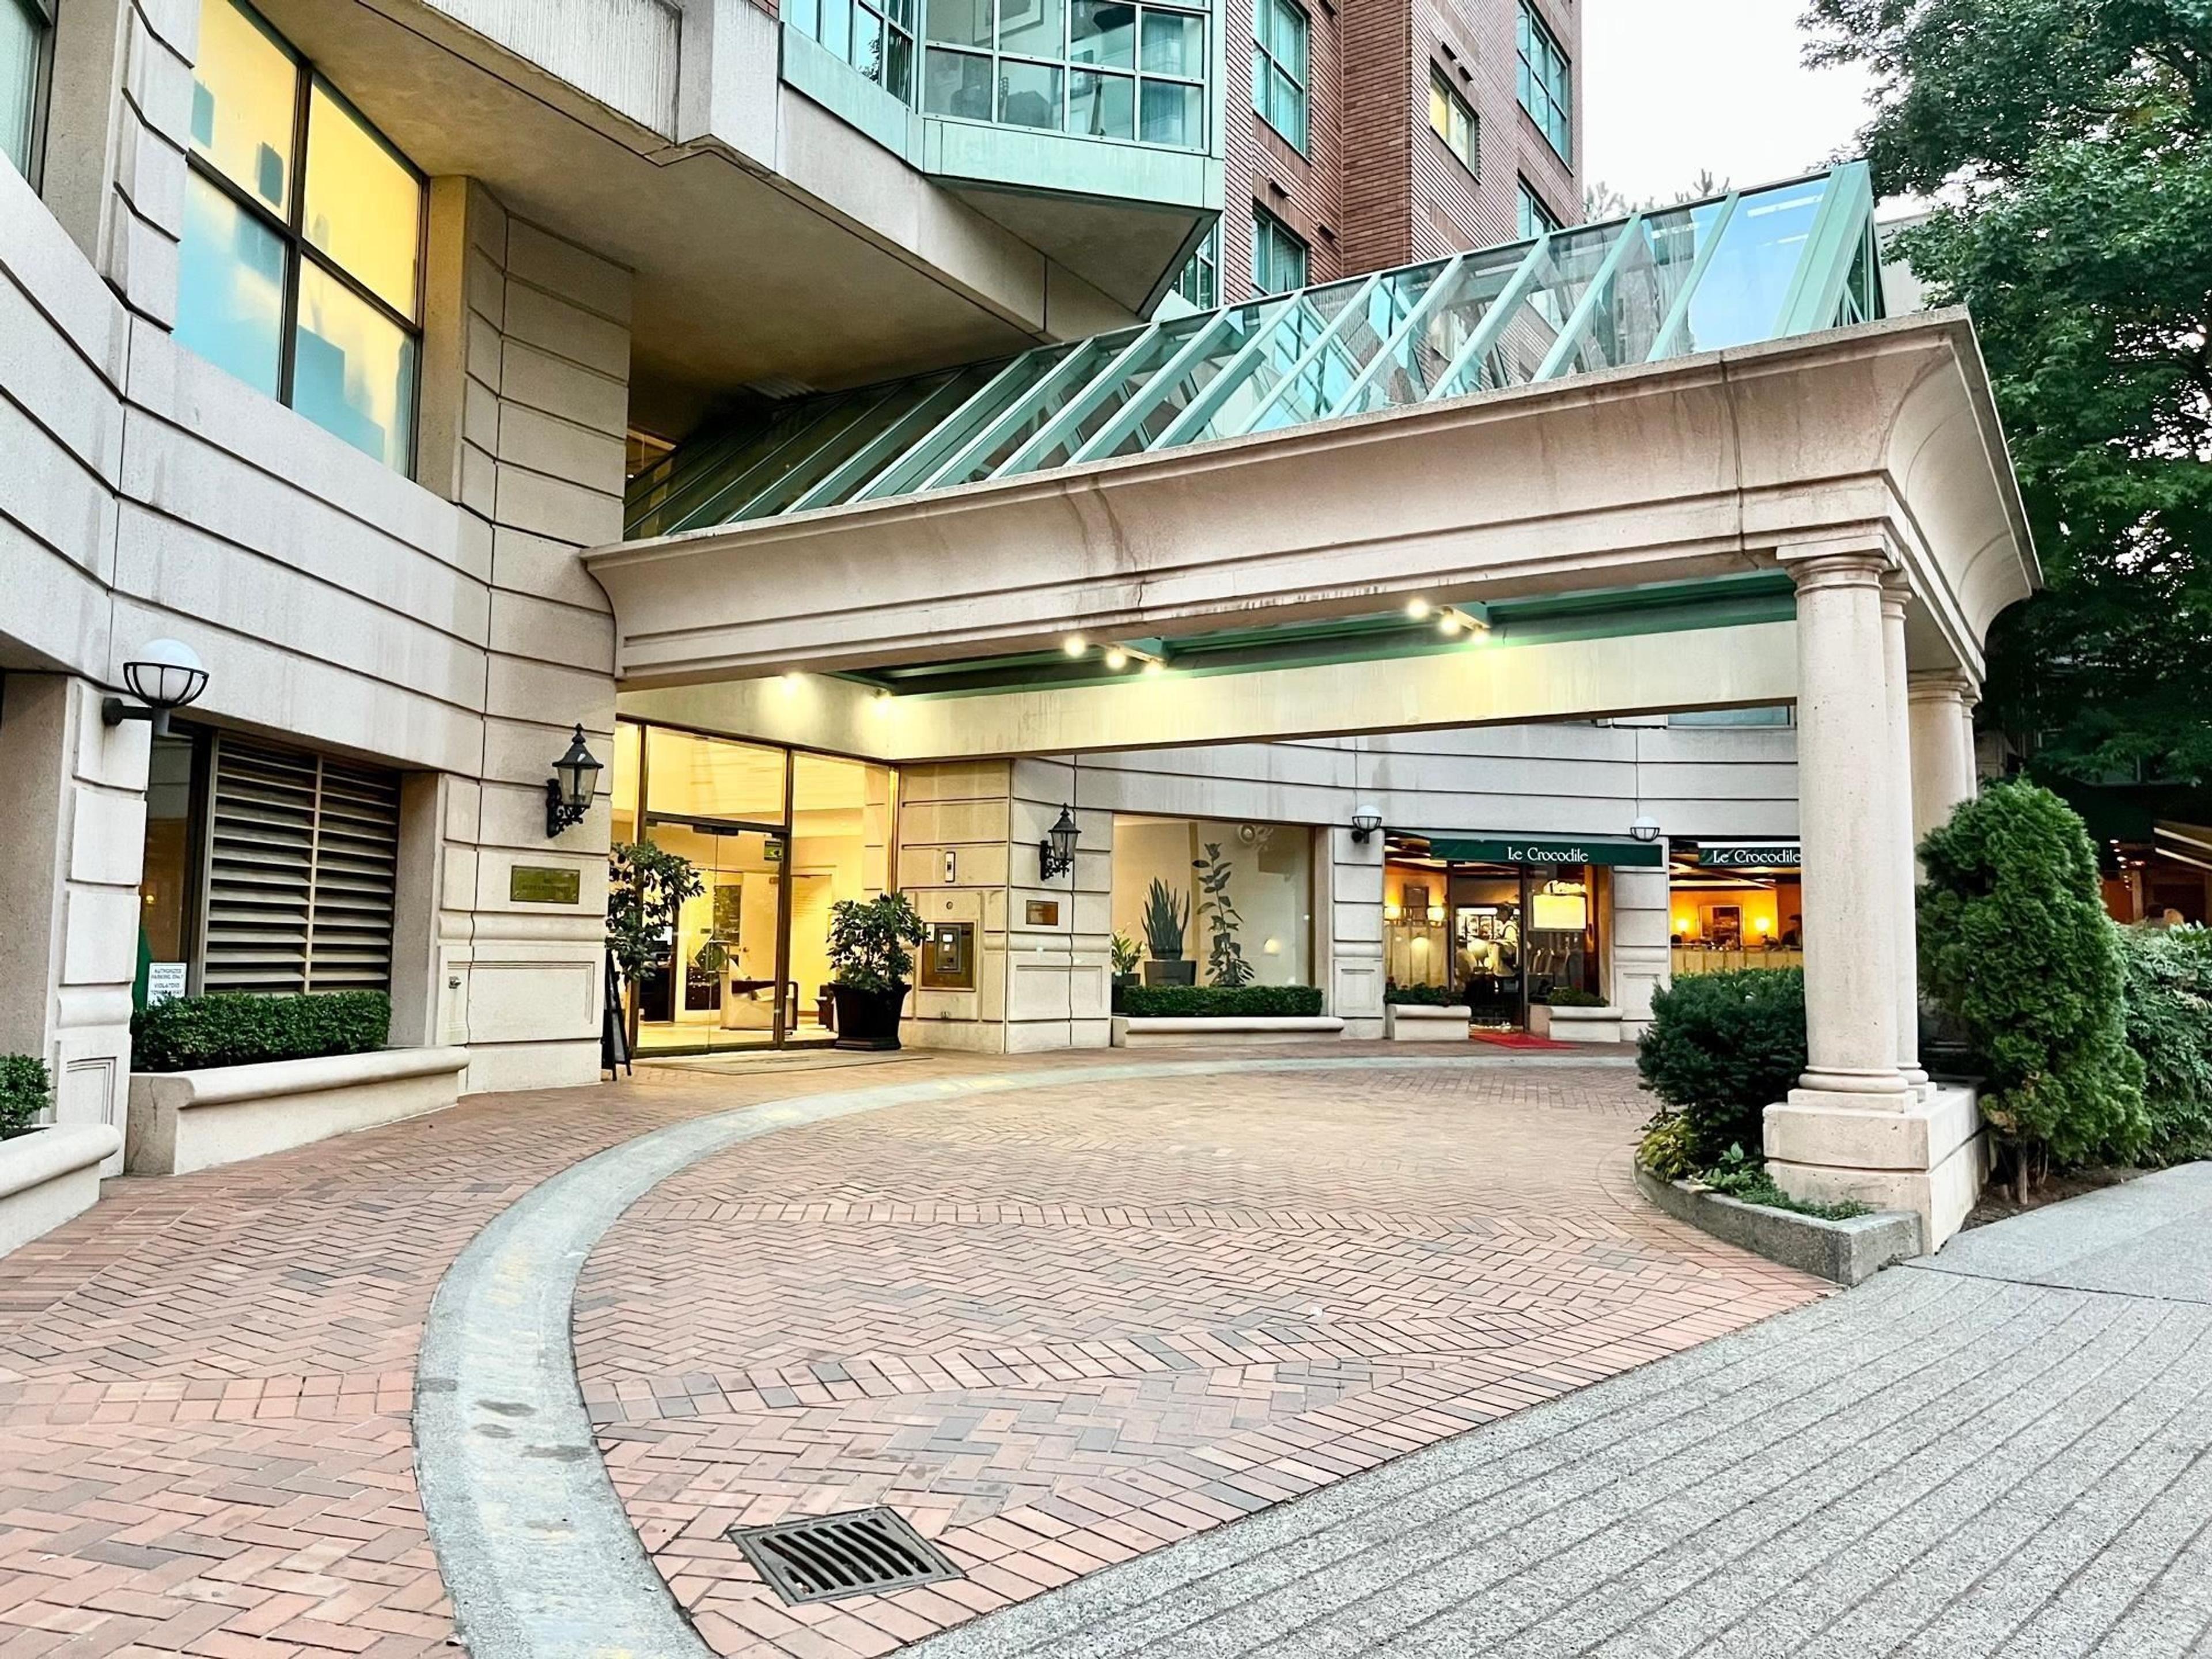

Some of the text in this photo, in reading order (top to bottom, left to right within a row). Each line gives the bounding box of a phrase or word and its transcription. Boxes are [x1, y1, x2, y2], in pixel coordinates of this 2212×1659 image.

[1508, 847, 1589, 862] Le Crocodile
[1713, 849, 1801, 863] Le Crocodile
